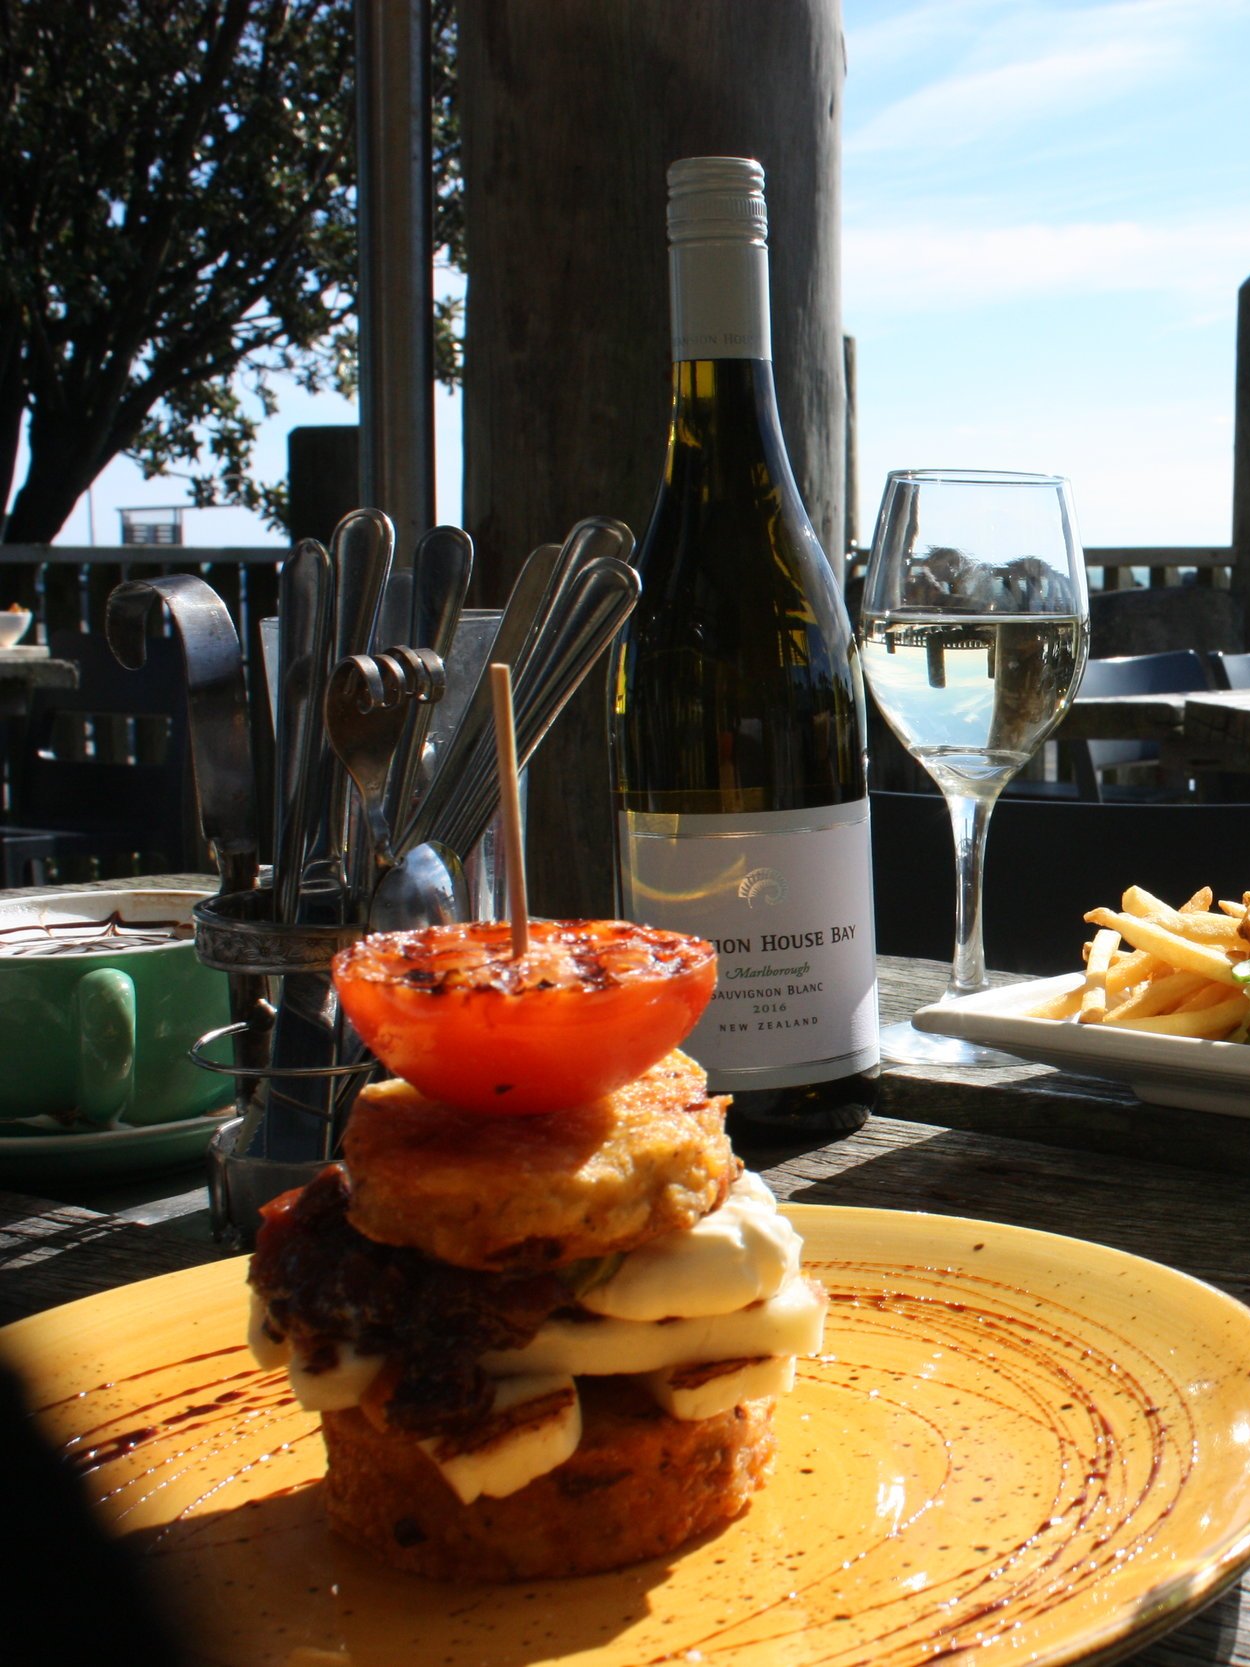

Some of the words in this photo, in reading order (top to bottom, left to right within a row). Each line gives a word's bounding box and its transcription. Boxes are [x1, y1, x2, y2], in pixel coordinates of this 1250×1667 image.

[761, 931, 825, 952] HOUSE
[831, 924, 857, 944] BAY
[725, 961, 811, 980] Marlborough
[711, 987, 782, 1001] SAUVIGNON
[787, 982, 824, 996] BLANC
[753, 1002, 787, 1014] 2016
[719, 1023, 749, 1032] NEW
[758, 1016, 818, 1031] ZEALAND
